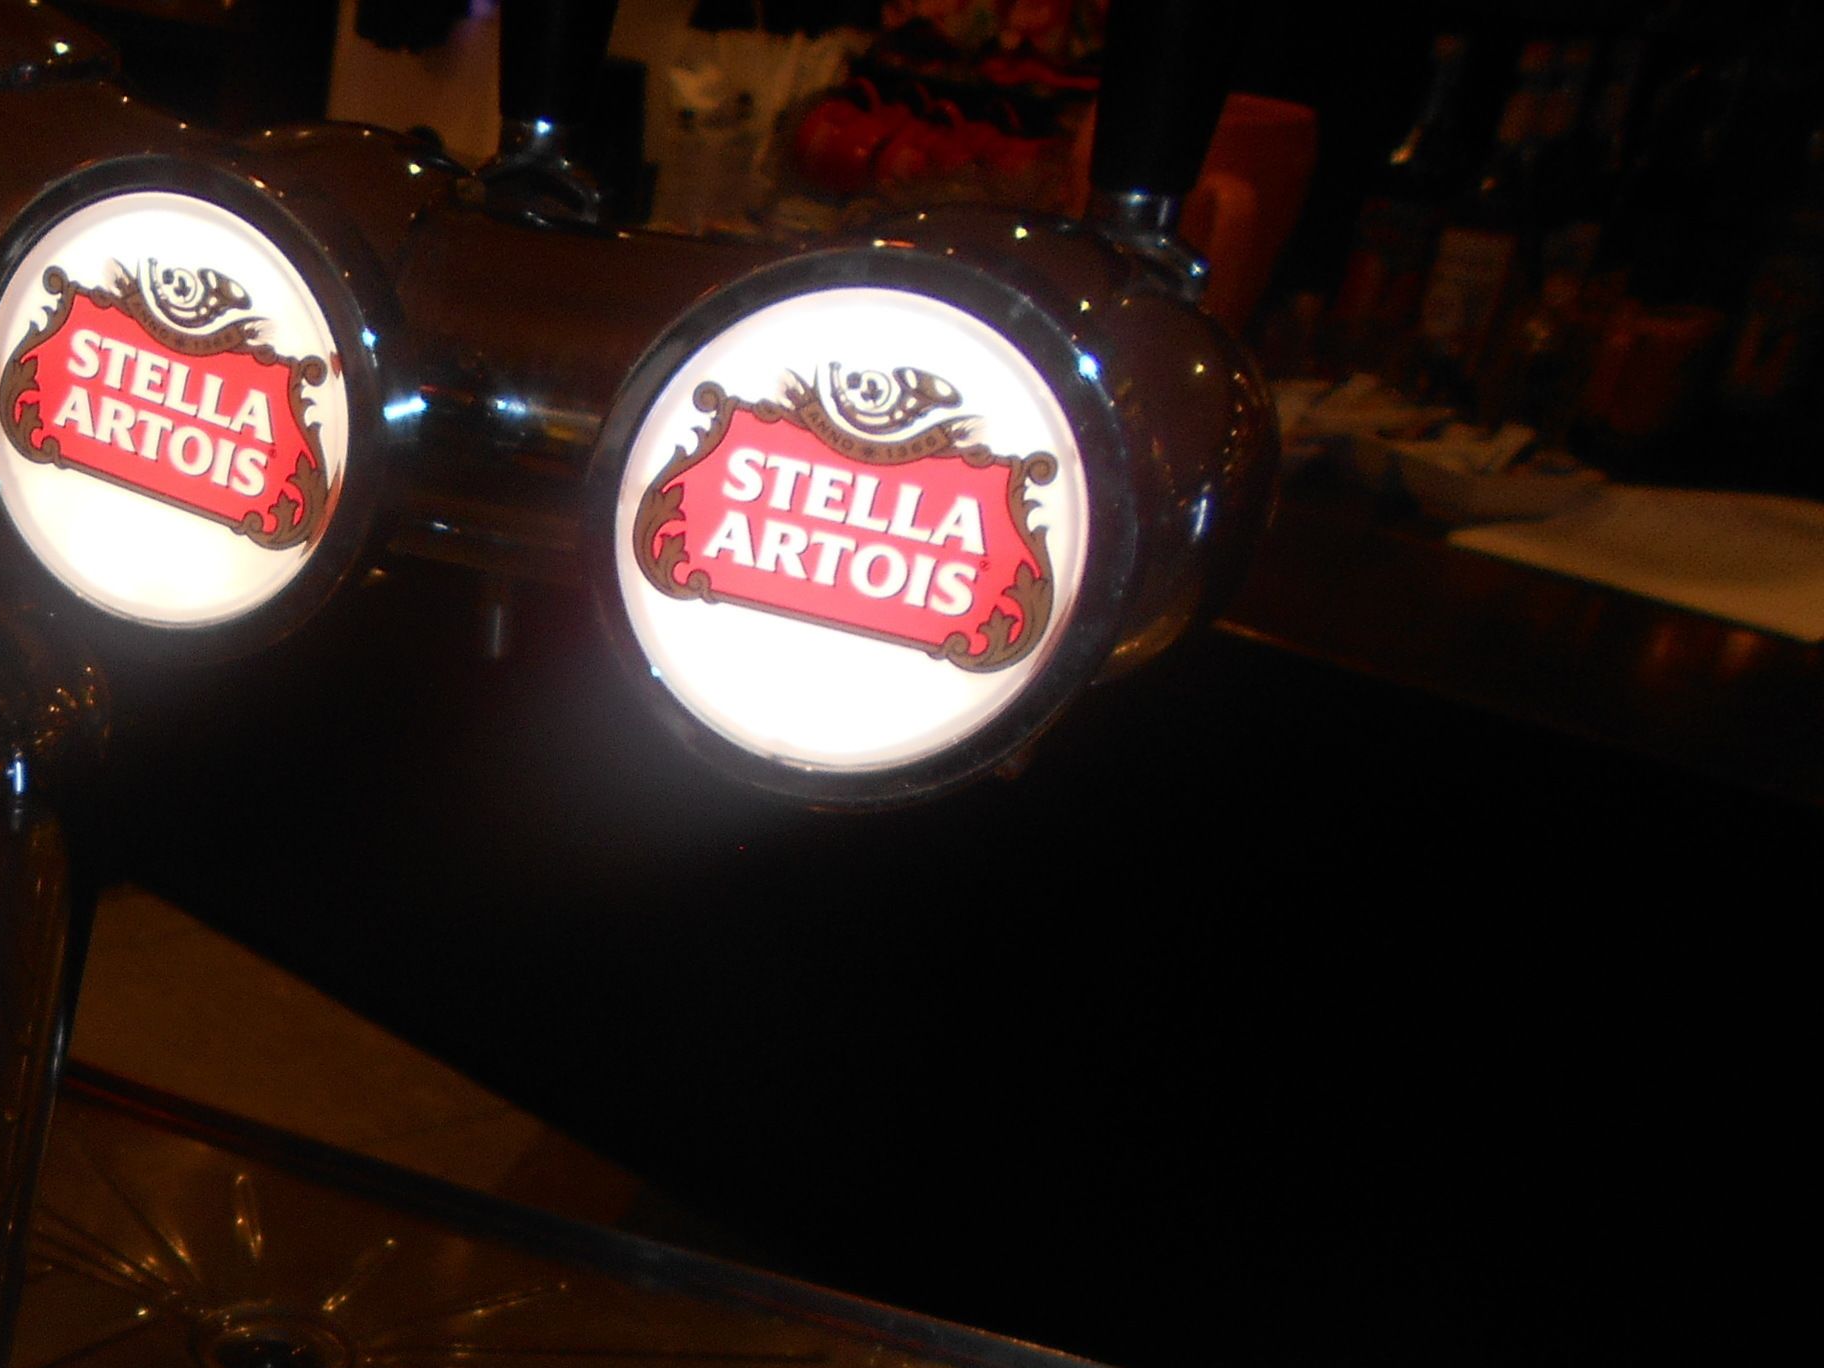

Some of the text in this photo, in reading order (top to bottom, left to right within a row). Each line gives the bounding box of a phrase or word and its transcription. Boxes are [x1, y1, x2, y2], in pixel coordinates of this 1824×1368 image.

[67, 328, 277, 446] STELLA
[53, 386, 269, 498] ARTOIS
[721, 448, 985, 555] STELLA
[704, 511, 978, 617] ARTOIS
